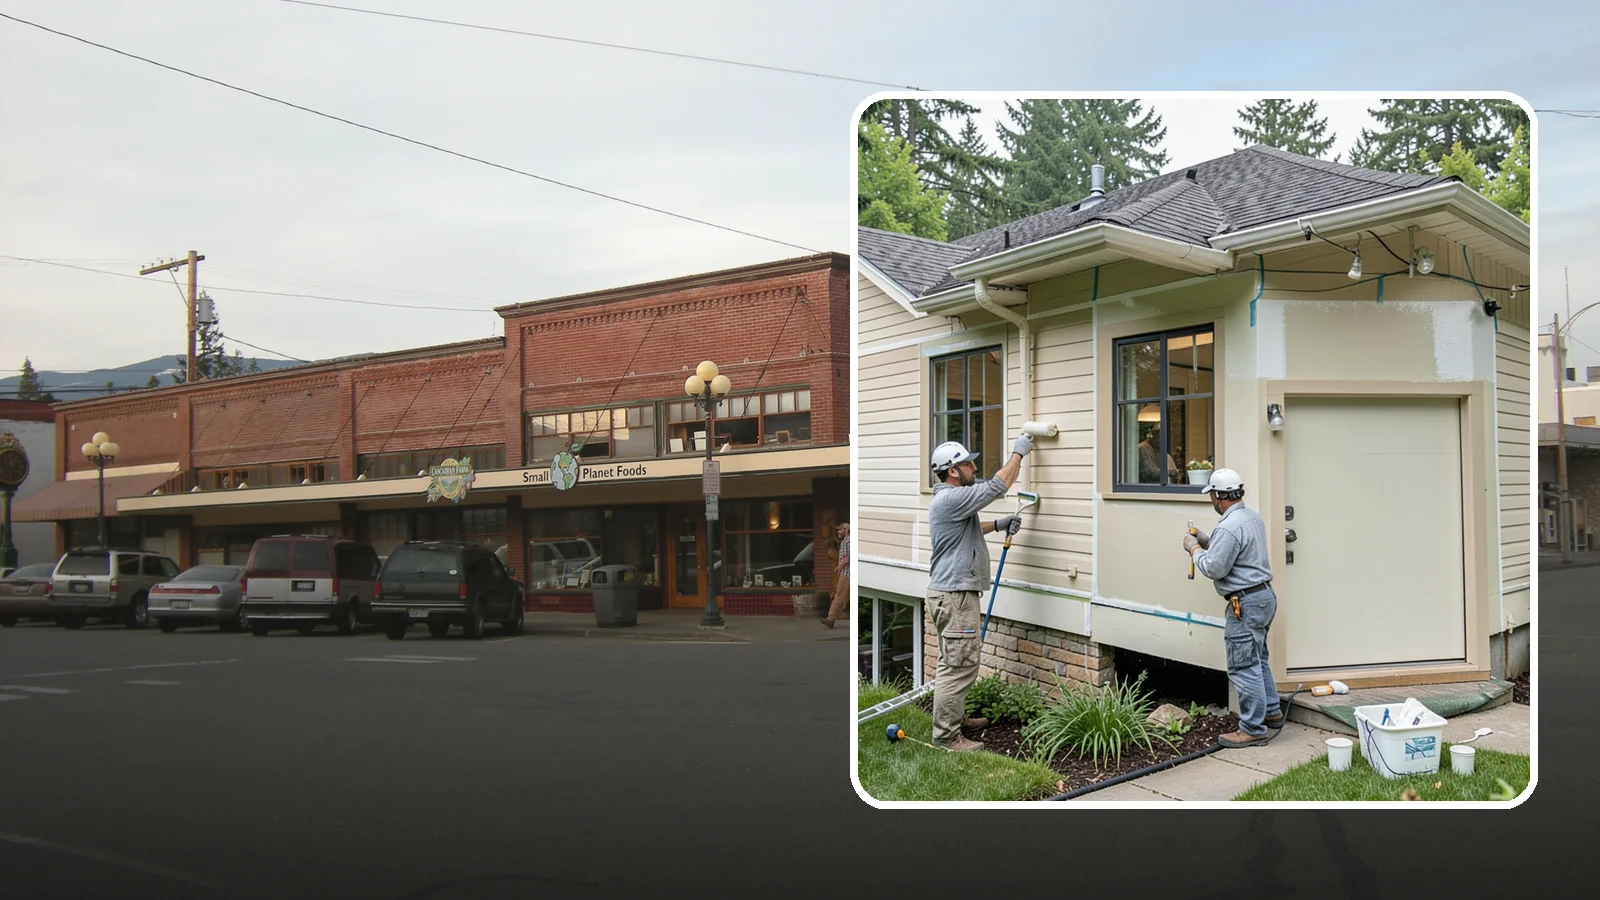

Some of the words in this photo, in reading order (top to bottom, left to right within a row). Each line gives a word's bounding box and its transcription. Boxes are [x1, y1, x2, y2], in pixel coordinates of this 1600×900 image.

[523, 471, 549, 483] Small
[583, 467, 614, 479] Planet
[617, 464, 647, 477] Foods
